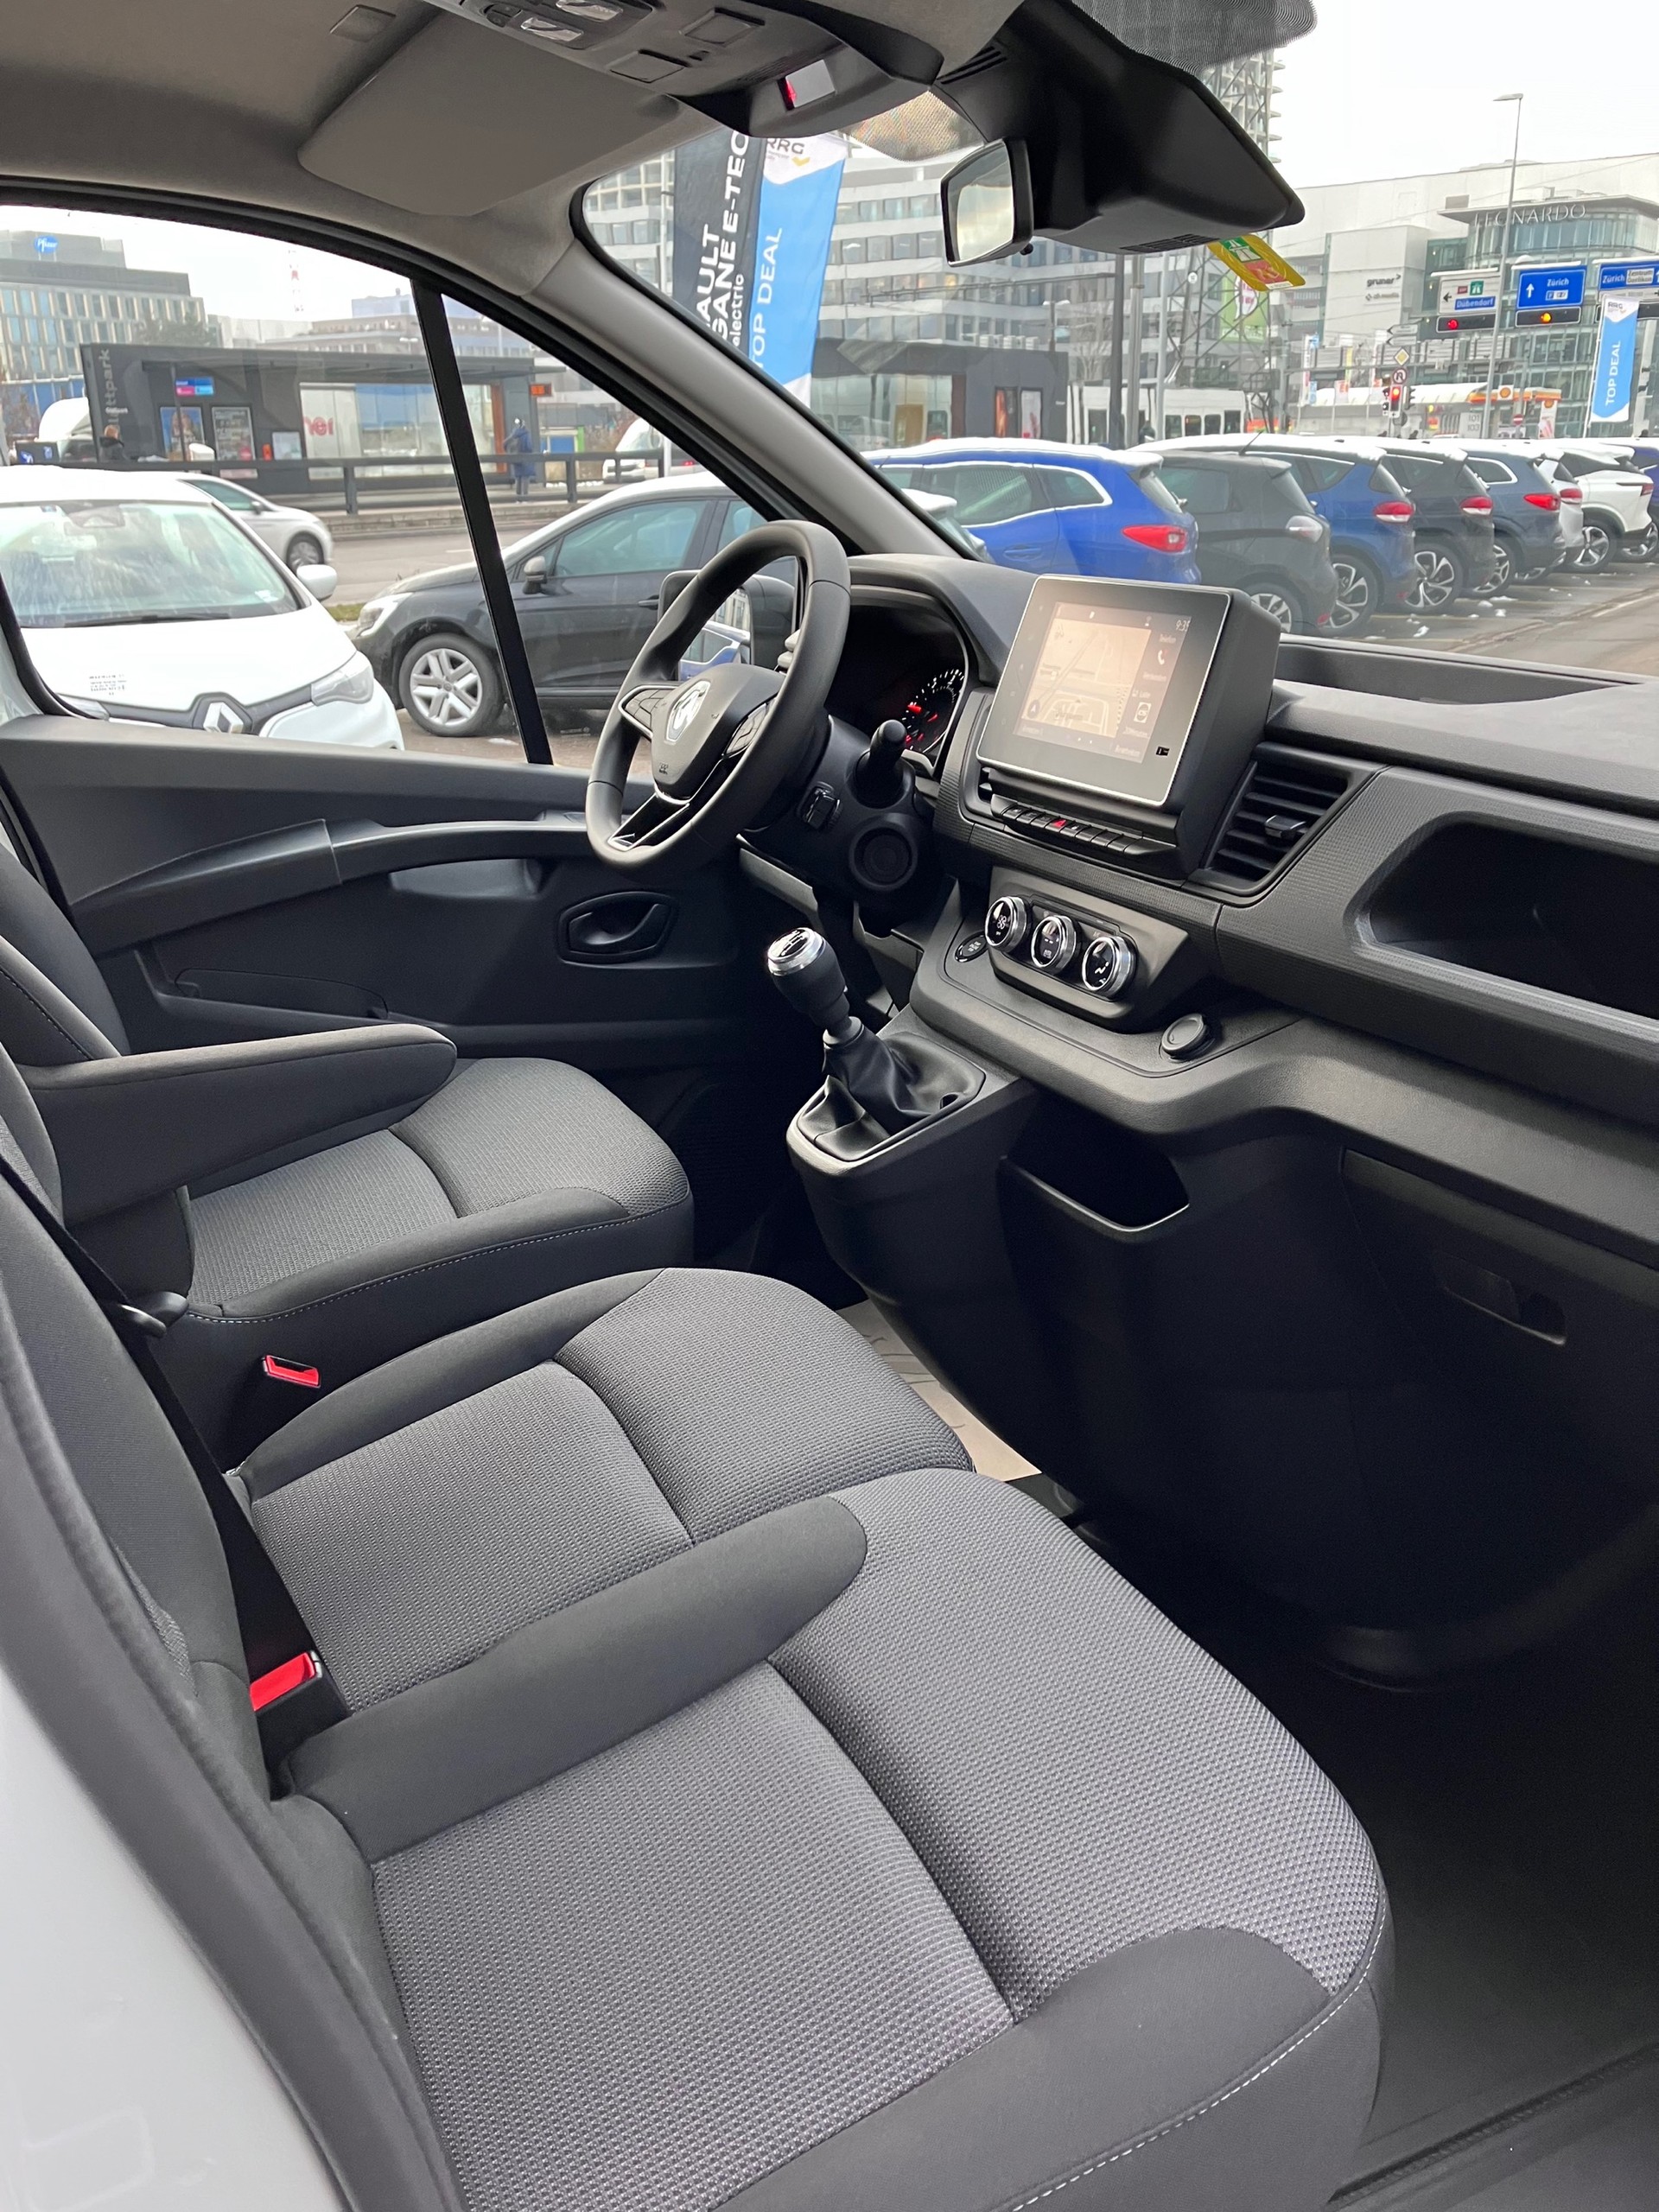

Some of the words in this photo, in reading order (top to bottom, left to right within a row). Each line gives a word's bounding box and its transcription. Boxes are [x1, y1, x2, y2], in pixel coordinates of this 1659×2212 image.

[696, 224, 719, 327] AULT
[758, 228, 782, 304] DEAL
[1603, 274, 1625, 284] Zürich
[1547, 278, 1569, 287] Zürich
[729, 273, 744, 346] electric
[1456, 297, 1494, 308] Dübendorf
[1609, 340, 1621, 376] DEAL
[1605, 378, 1618, 406] TOP
